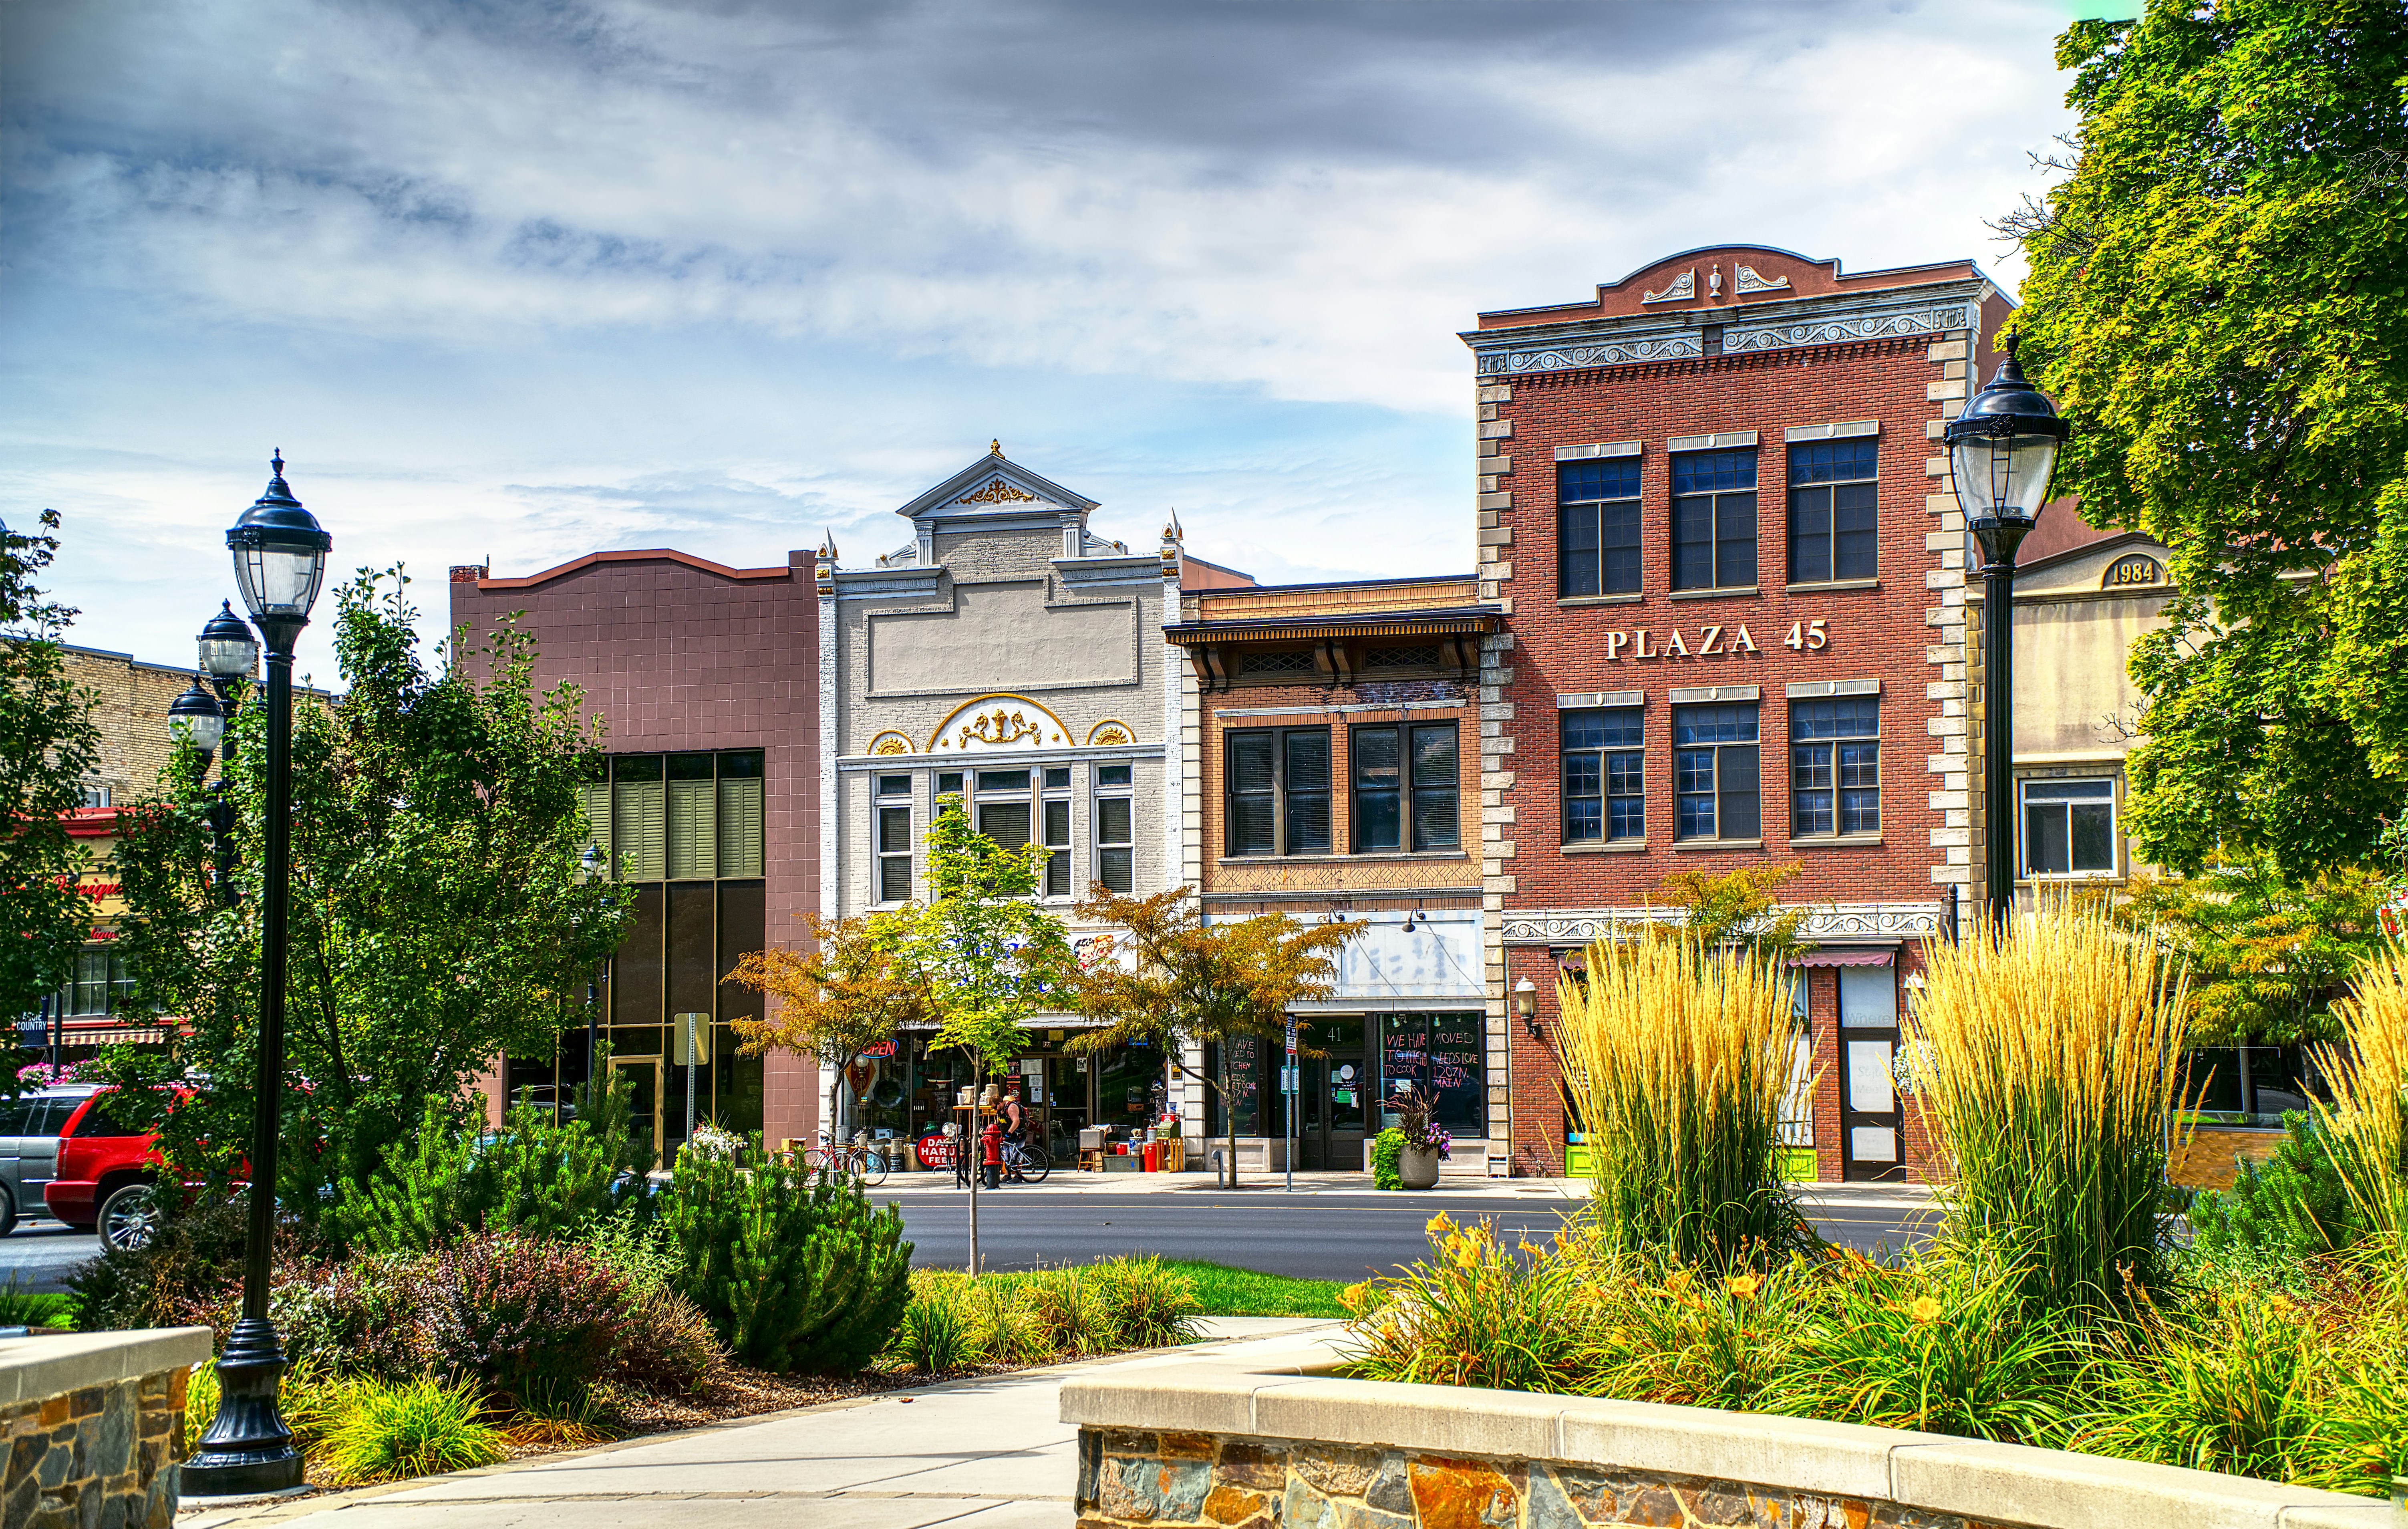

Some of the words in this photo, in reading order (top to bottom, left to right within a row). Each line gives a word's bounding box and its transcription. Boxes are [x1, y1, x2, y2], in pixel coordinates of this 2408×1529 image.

[2112, 562, 2154, 583] 1984
[1604, 623, 1759, 659] PLAZA
[1784, 619, 1826, 650] 45
[17, 1021, 47, 1031] COUNTRY
[1327, 1027, 1341, 1041] 41
[1387, 1034, 1405, 1048] WE
[1408, 1033, 1426, 1048] HAVE
[1433, 1032, 1474, 1045] MOVED
[862, 1041, 896, 1055] OPEN
[1237, 1039, 1254, 1050] AVE
[1385, 1050, 1403, 1062] TO
[1462, 1052, 1478, 1064] LOVE
[1384, 1064, 1395, 1077] TO
[1396, 1064, 1417, 1077] COOK
[1433, 1065, 1458, 1078] 1207
[1433, 1078, 1462, 1088] MAIN
[921, 1148, 955, 1156] HARU
